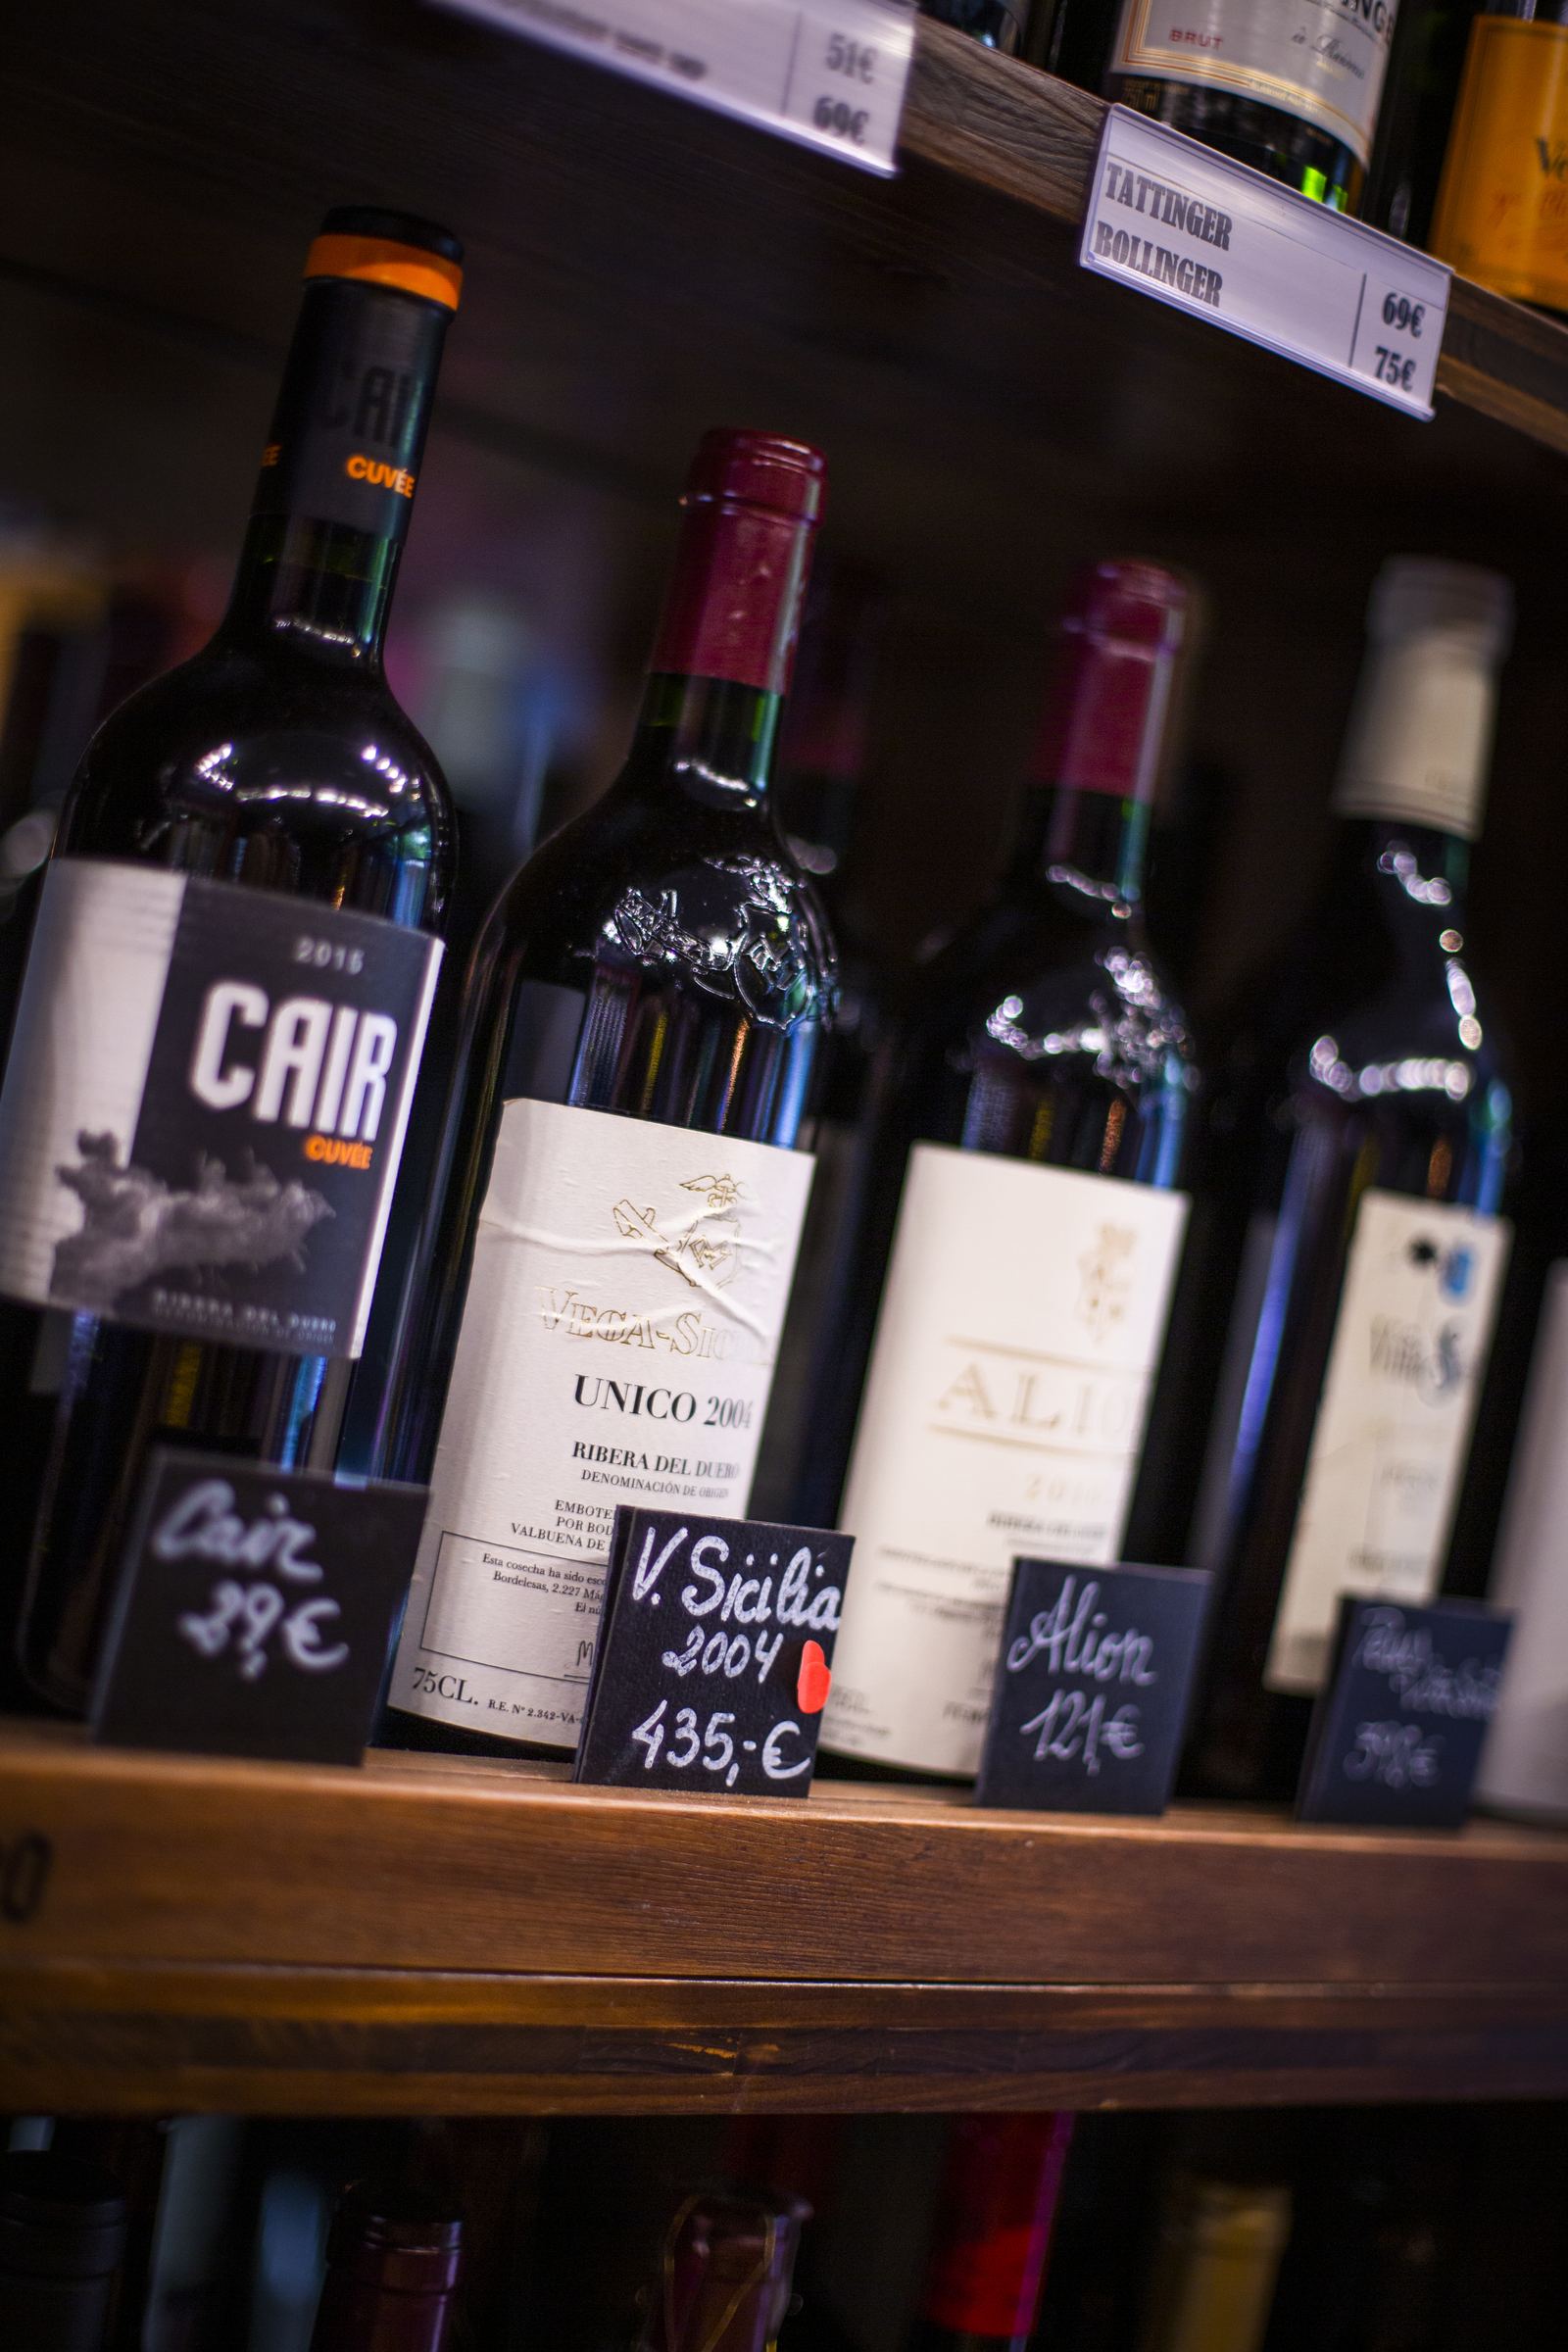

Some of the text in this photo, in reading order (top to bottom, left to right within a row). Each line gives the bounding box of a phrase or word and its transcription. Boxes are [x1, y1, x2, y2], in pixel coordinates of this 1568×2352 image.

[824, 31, 879, 85] 51€
[1168, 28, 1223, 48] BRUT
[1105, 161, 1426, 339] TATTINGER 69€
[1094, 220, 1417, 392] BOLLINGER 75€
[346, 454, 416, 498] CUVÉE
[193, 981, 398, 1143] CAIR
[574, 1373, 697, 1422] UNICO
[571, 1441, 649, 1470] RIBERA
[656, 1455, 691, 1476] DEL
[581, 1469, 680, 1494] DENOMINACIÓN
[683, 1487, 697, 1497] DE
[154, 1479, 323, 1584] Cair
[555, 1499, 613, 1520] EMBOTE
[556, 1516, 583, 1532] POR
[511, 1523, 606, 1551] VALBUENA DE
[482, 1552, 504, 1567] Esta
[506, 1560, 545, 1576] cosecha
[548, 1567, 562, 1579] ha
[564, 1570, 585, 1583] sido
[493, 1570, 549, 1592] Bordelesas,
[552, 1583, 581, 1596] 2.227
[632, 1526, 689, 1606] V.
[681, 1535, 841, 1632] Sicilia
[662, 1623, 784, 1684] 2004
[1006, 1574, 1160, 1688] Alion
[412, 1667, 479, 1706] 75CL.
[487, 1698, 510, 1713] R.E.
[527, 1708, 584, 1725] 2.342-VA-
